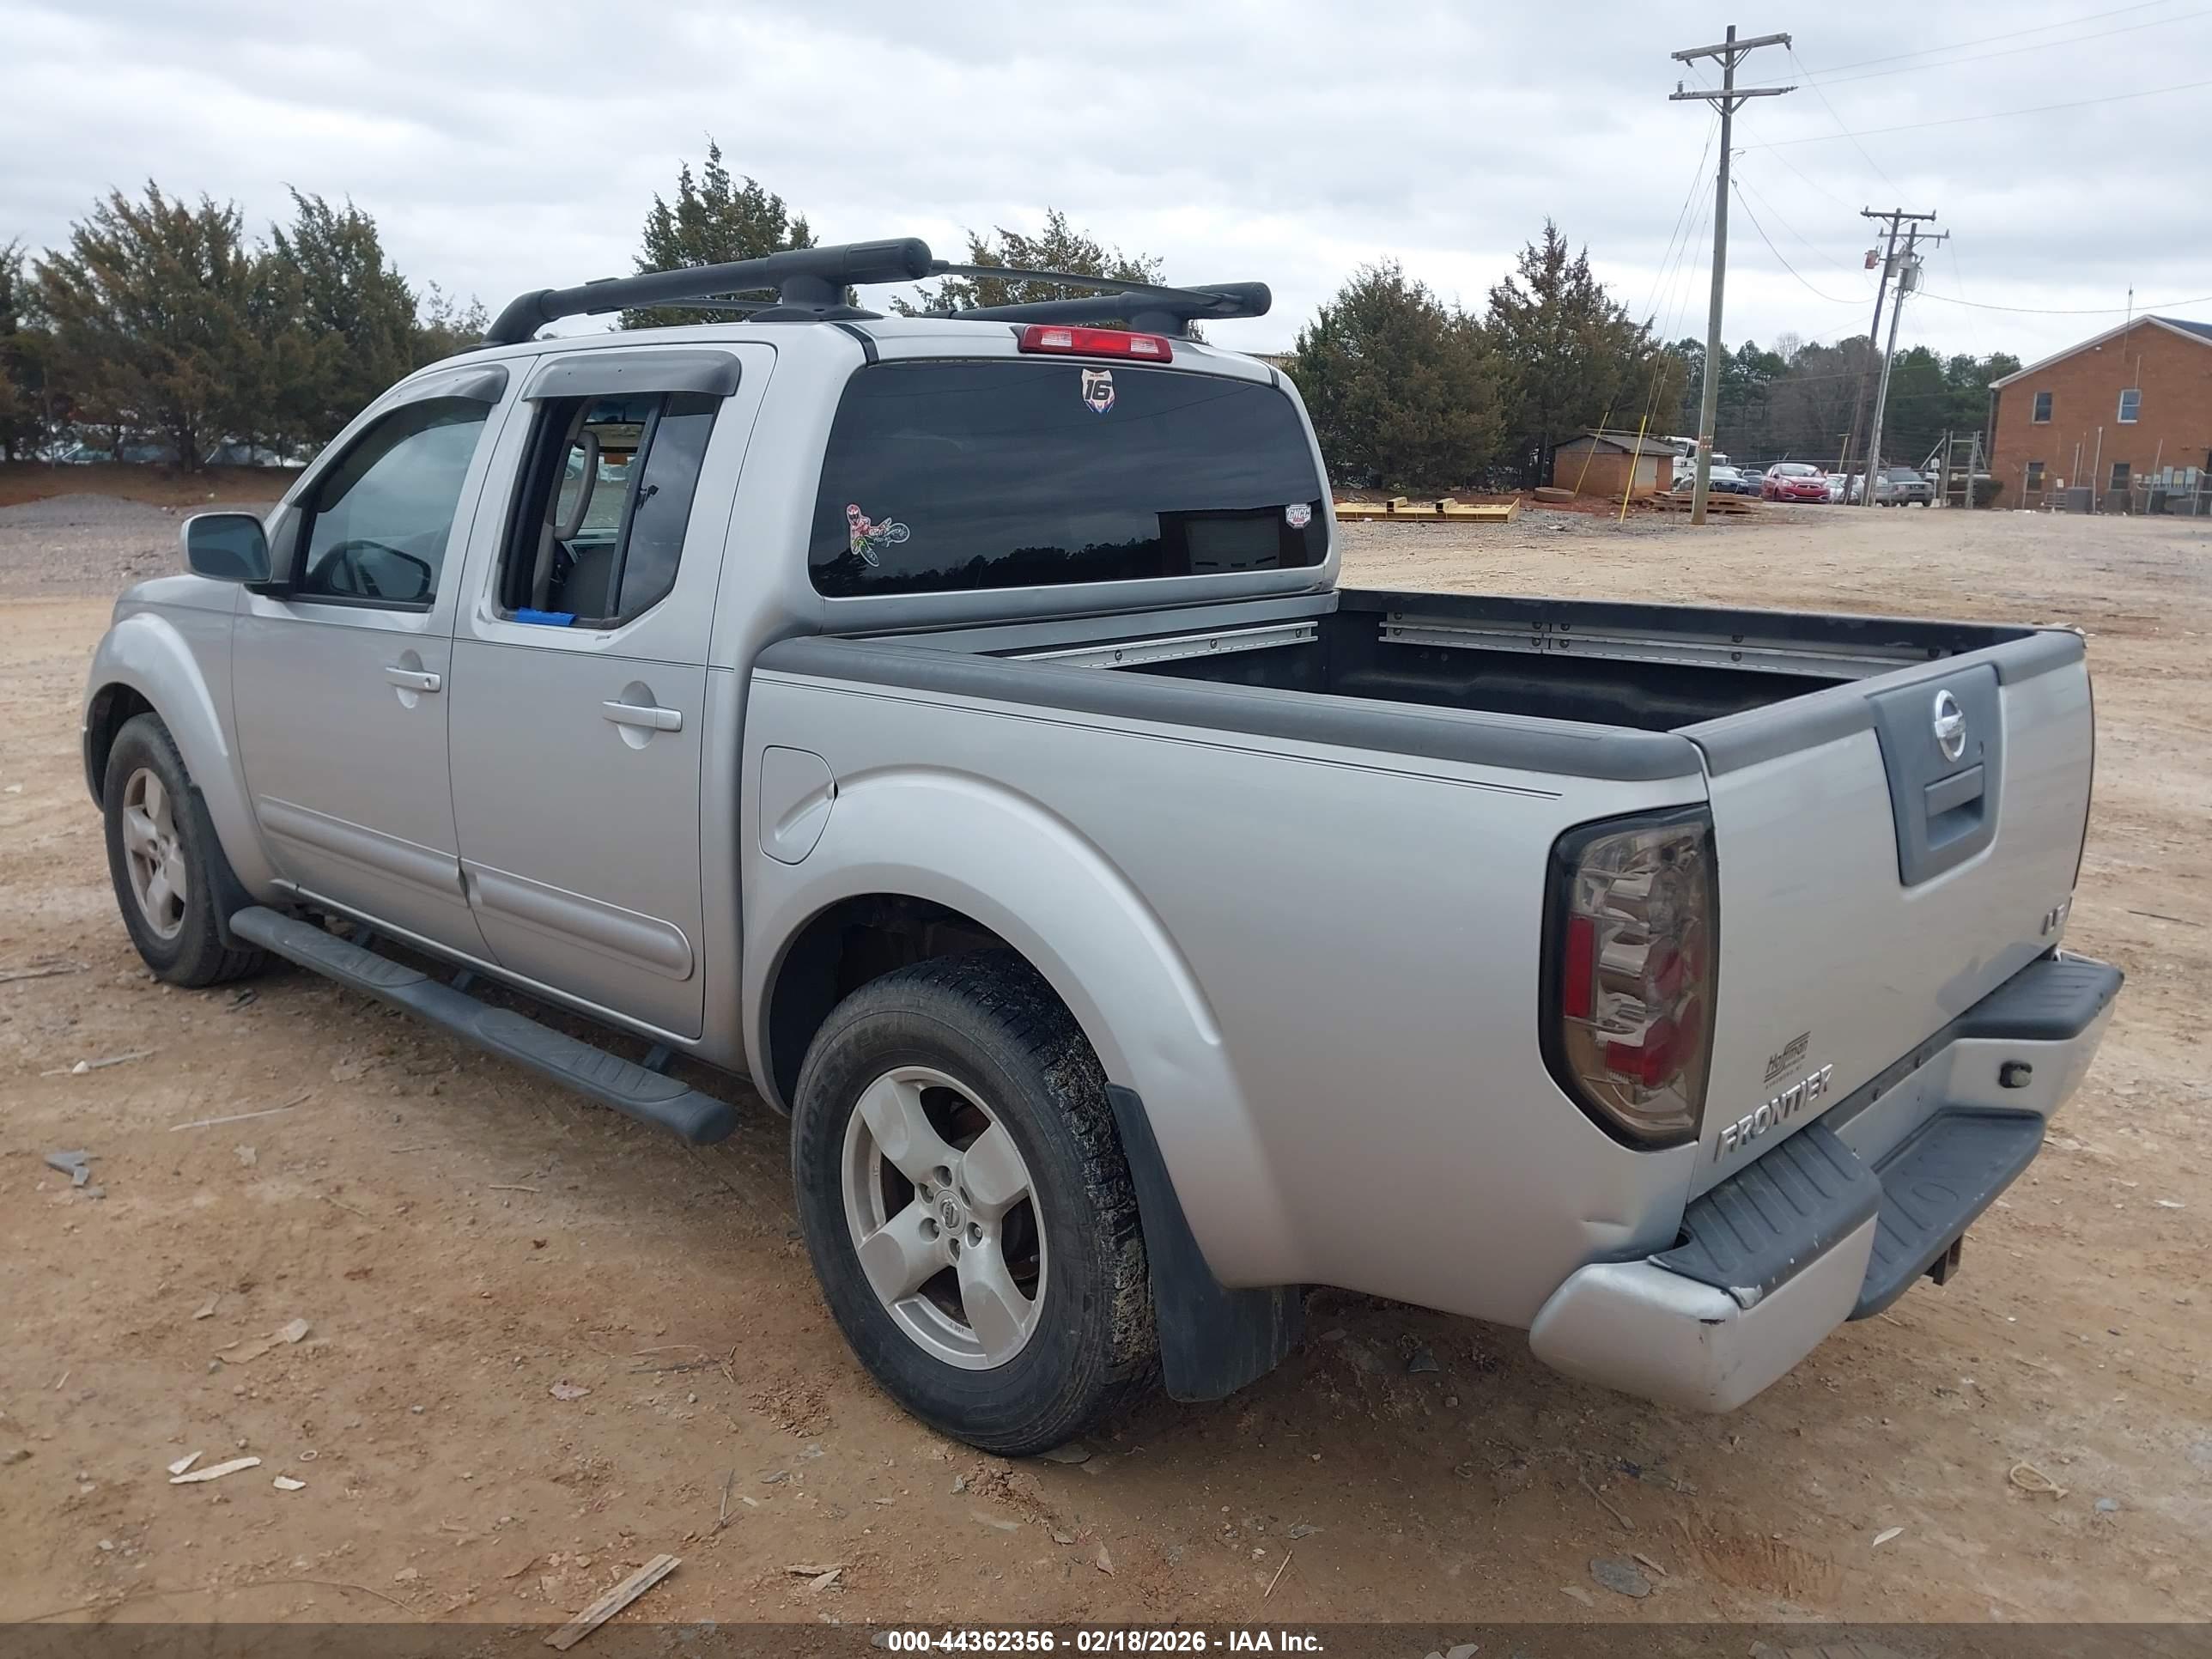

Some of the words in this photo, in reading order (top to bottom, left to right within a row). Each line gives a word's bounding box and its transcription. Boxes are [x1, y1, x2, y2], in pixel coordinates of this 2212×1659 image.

[1085, 379, 1112, 401] 16
[1287, 508, 1310, 520] GNCC
[1714, 1063, 1833, 1164] FRONTIER
